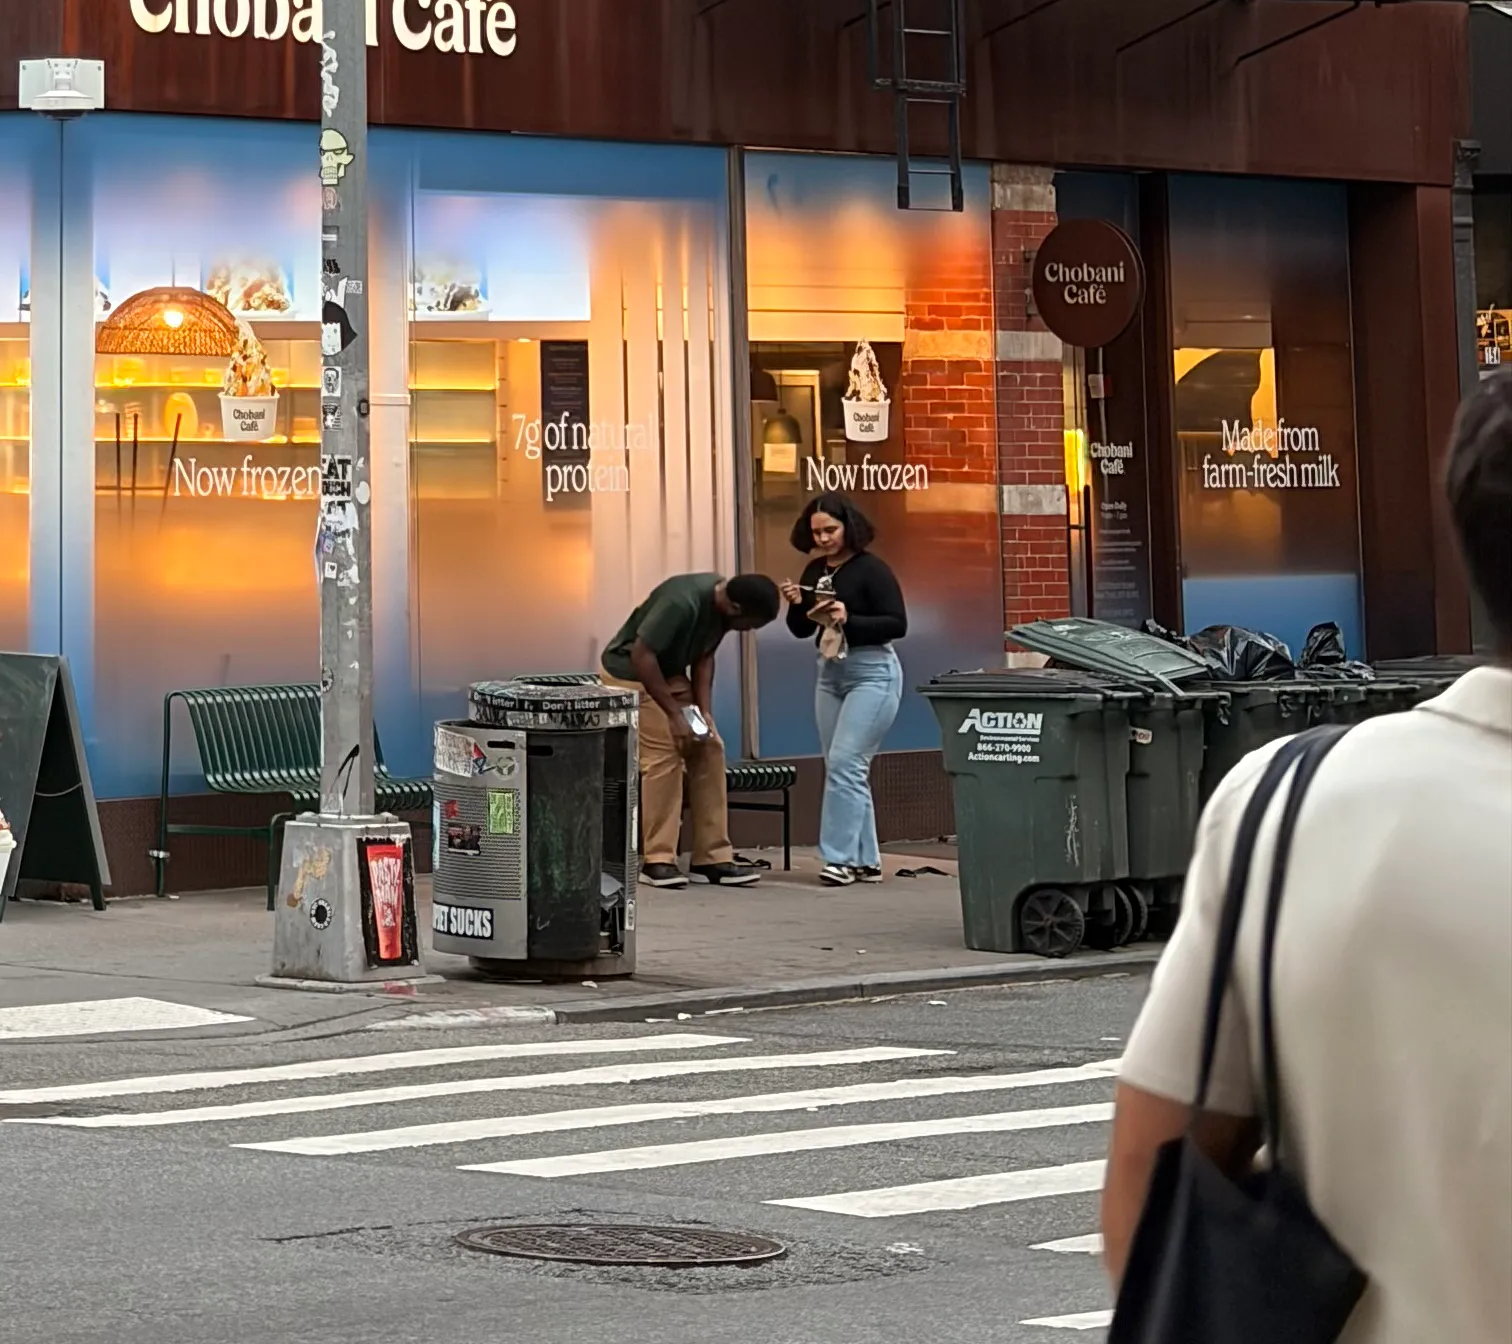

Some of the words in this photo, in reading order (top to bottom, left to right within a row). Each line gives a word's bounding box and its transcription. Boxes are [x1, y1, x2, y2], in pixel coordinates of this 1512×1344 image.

[1044, 260, 1125, 282] Chobani
[1064, 283, 1107, 304] Café
[512, 413, 541, 459] 7g
[544, 411, 570, 450] of
[572, 414, 654, 450] natural
[1090, 441, 1133, 459] Chobani
[1221, 419, 1273, 451] Made
[1277, 418, 1320, 451] from
[173, 457, 236, 497] Now
[241, 455, 322, 497] frozen
[545, 456, 630, 502] protein
[806, 456, 859, 491] Now
[861, 454, 928, 491] frozen
[1100, 459, 1124, 475] Café
[1202, 453, 1299, 488] farm-fresh
[1301, 454, 1340, 487] milk
[542, 700, 572, 710] Don't
[958, 708, 1043, 735] ACTION
[450, 907, 492, 938] SUCKS
